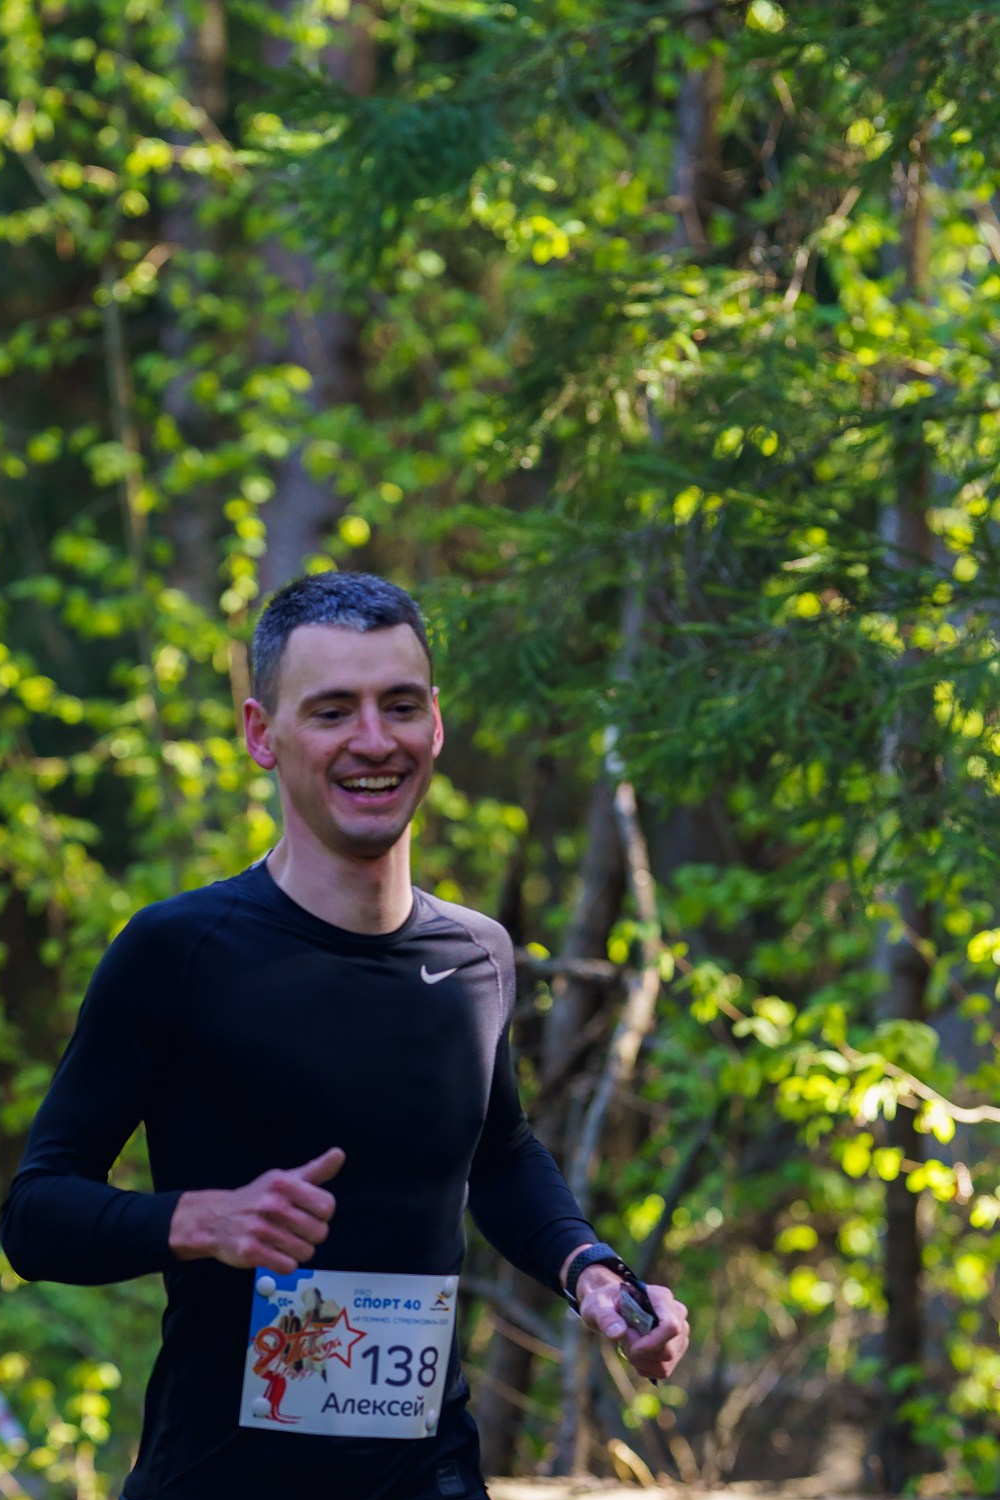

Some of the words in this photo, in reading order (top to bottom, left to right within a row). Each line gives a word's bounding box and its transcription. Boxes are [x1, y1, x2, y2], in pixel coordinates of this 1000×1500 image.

[353, 1297, 401, 1310] СПОРТ
[403, 1299, 421, 1310] 40
[361, 1344, 439, 1387] 138
[321, 1392, 425, 1417] Алексей
